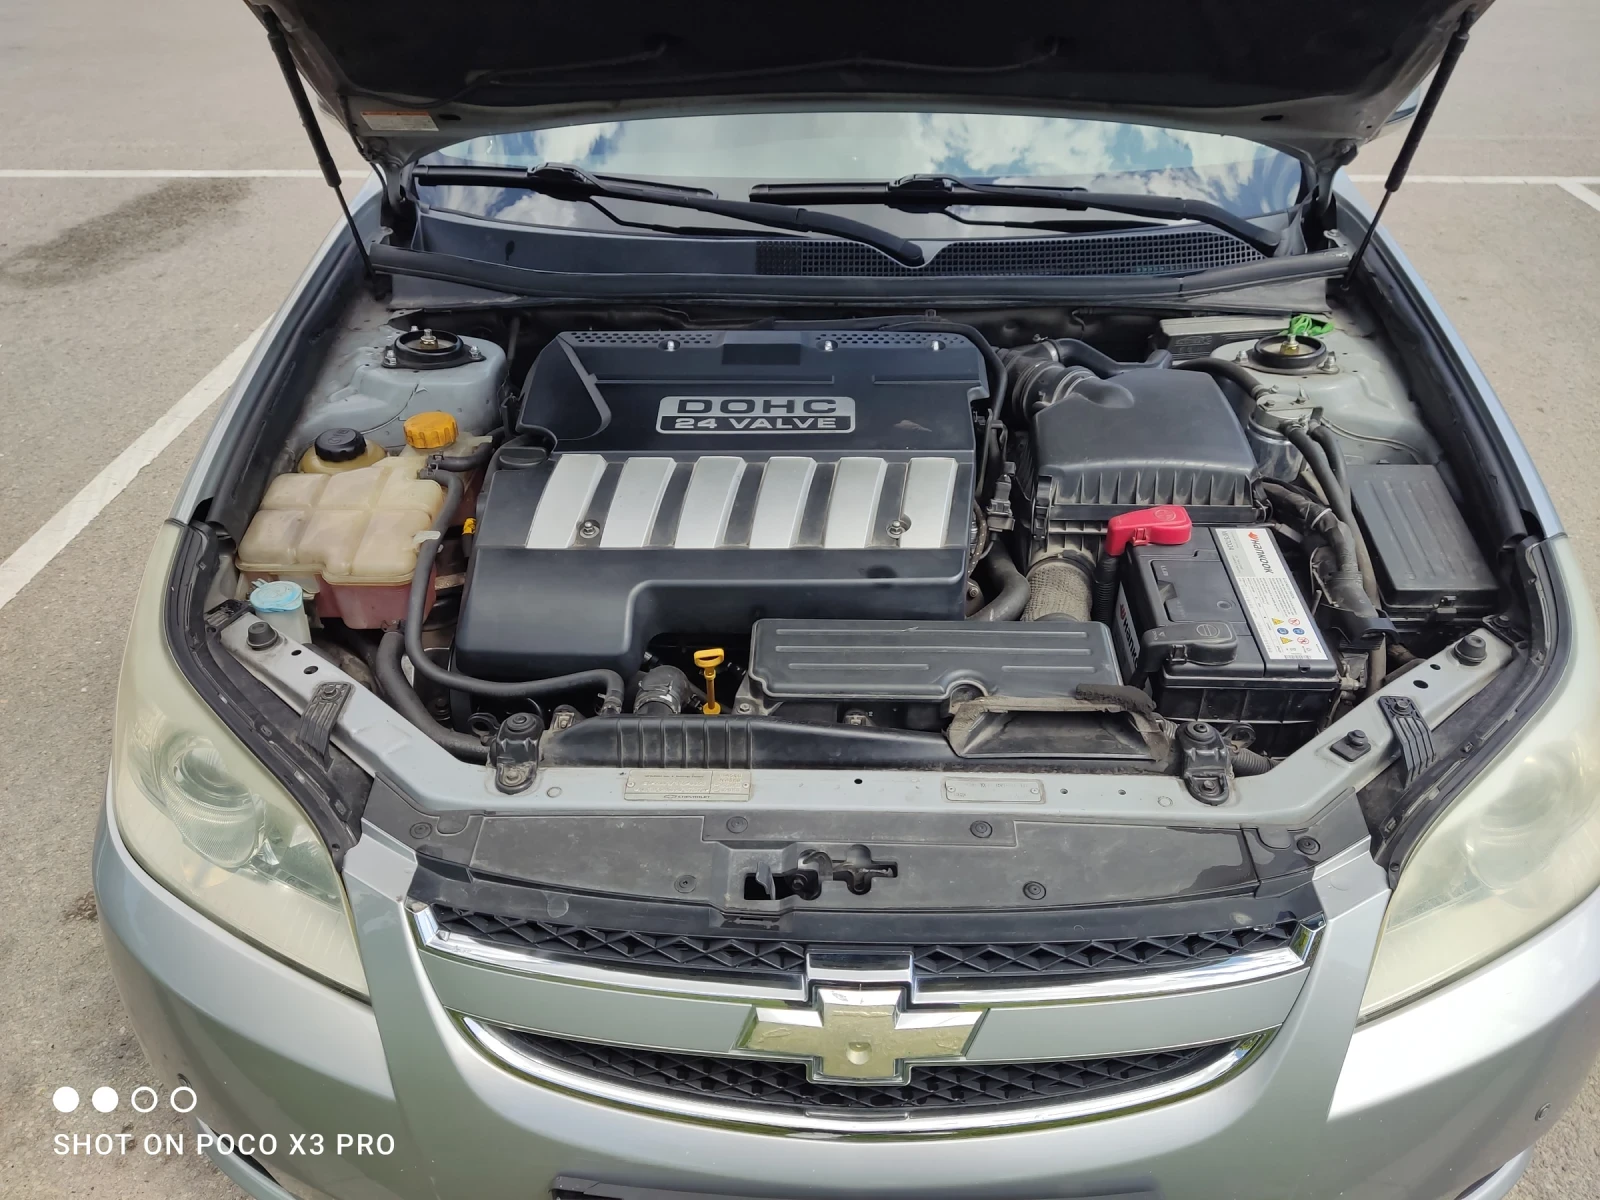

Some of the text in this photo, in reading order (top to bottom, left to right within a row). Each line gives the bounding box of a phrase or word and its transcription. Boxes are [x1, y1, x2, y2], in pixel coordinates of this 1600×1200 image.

[677, 399, 836, 414] DOHC
[675, 418, 836, 429] 24 VALVE
